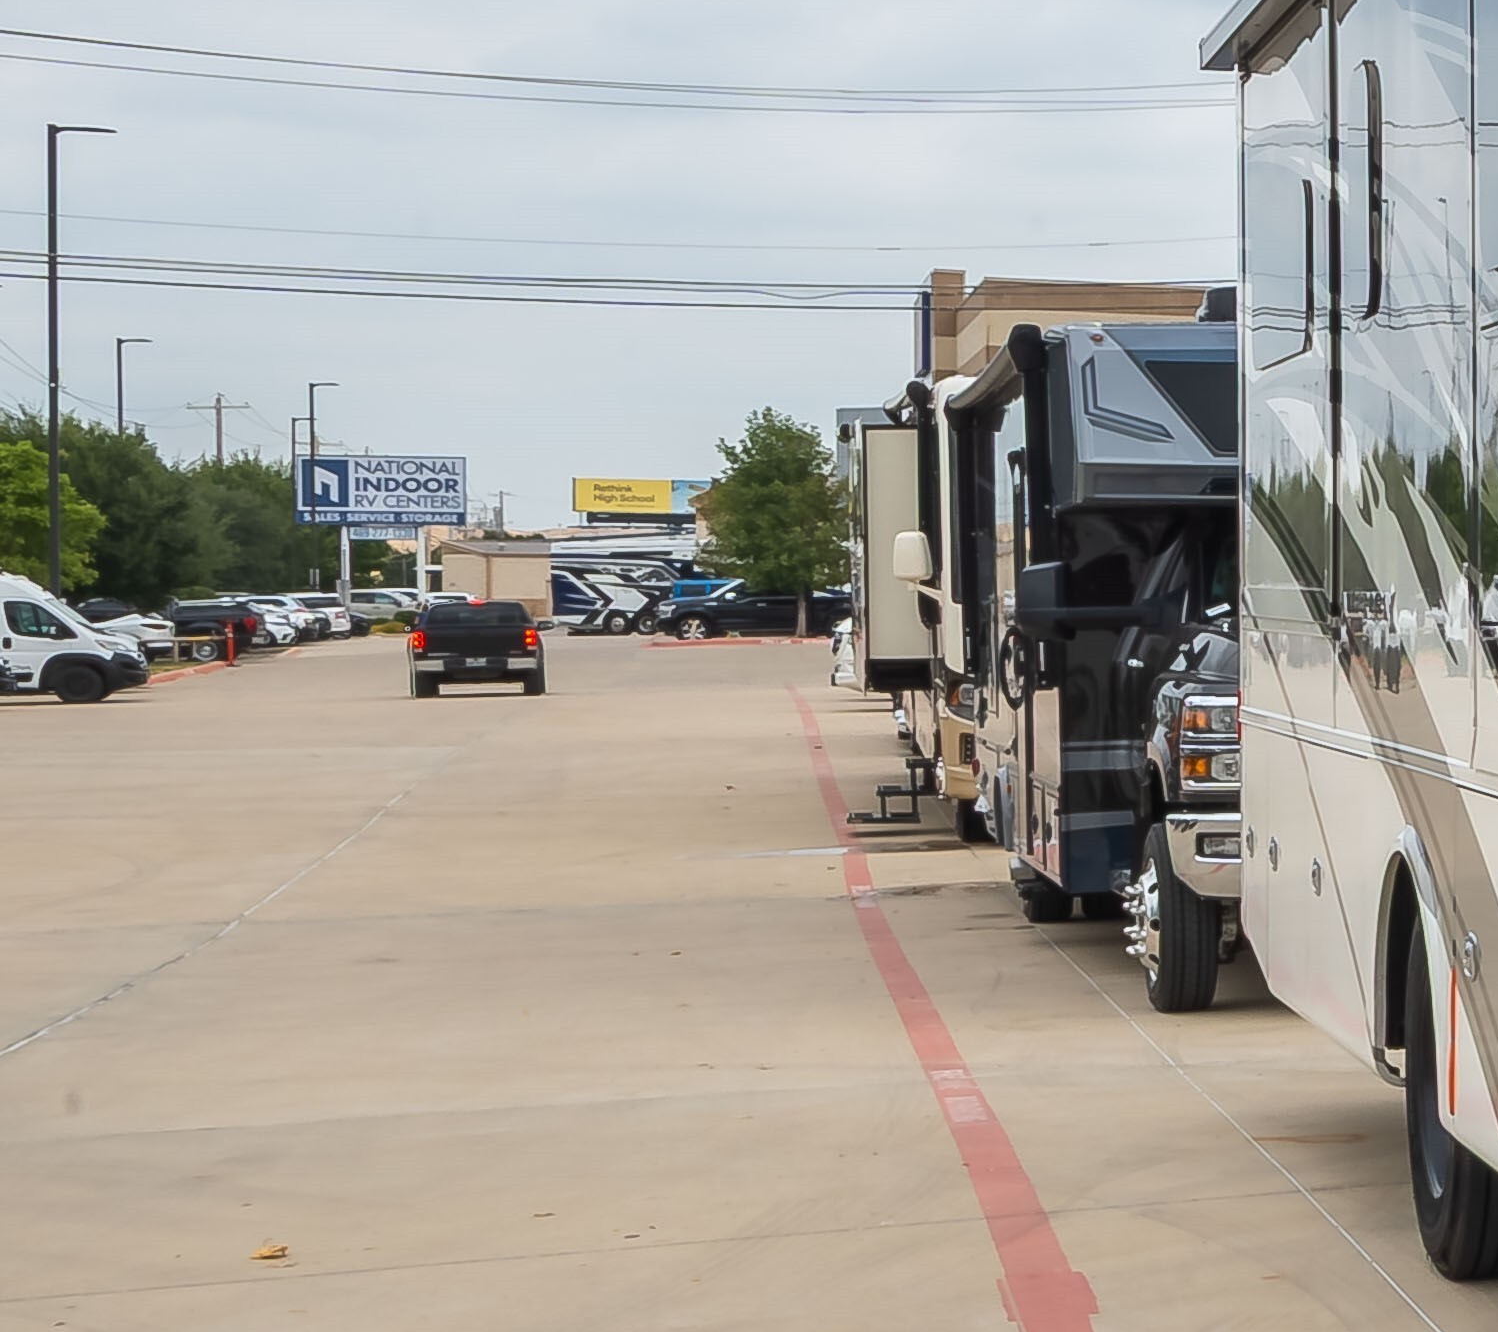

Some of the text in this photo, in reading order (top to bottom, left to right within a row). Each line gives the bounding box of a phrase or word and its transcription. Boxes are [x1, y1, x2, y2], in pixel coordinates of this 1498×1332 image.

[354, 460, 460, 476] NATIONAL
[354, 477, 460, 494] INDOOR
[593, 483, 632, 493] Rethink
[354, 495, 461, 509] RV CENTERS
[593, 494, 655, 504] High School
[303, 512, 458, 524] SALES SERVICE STORAGE
